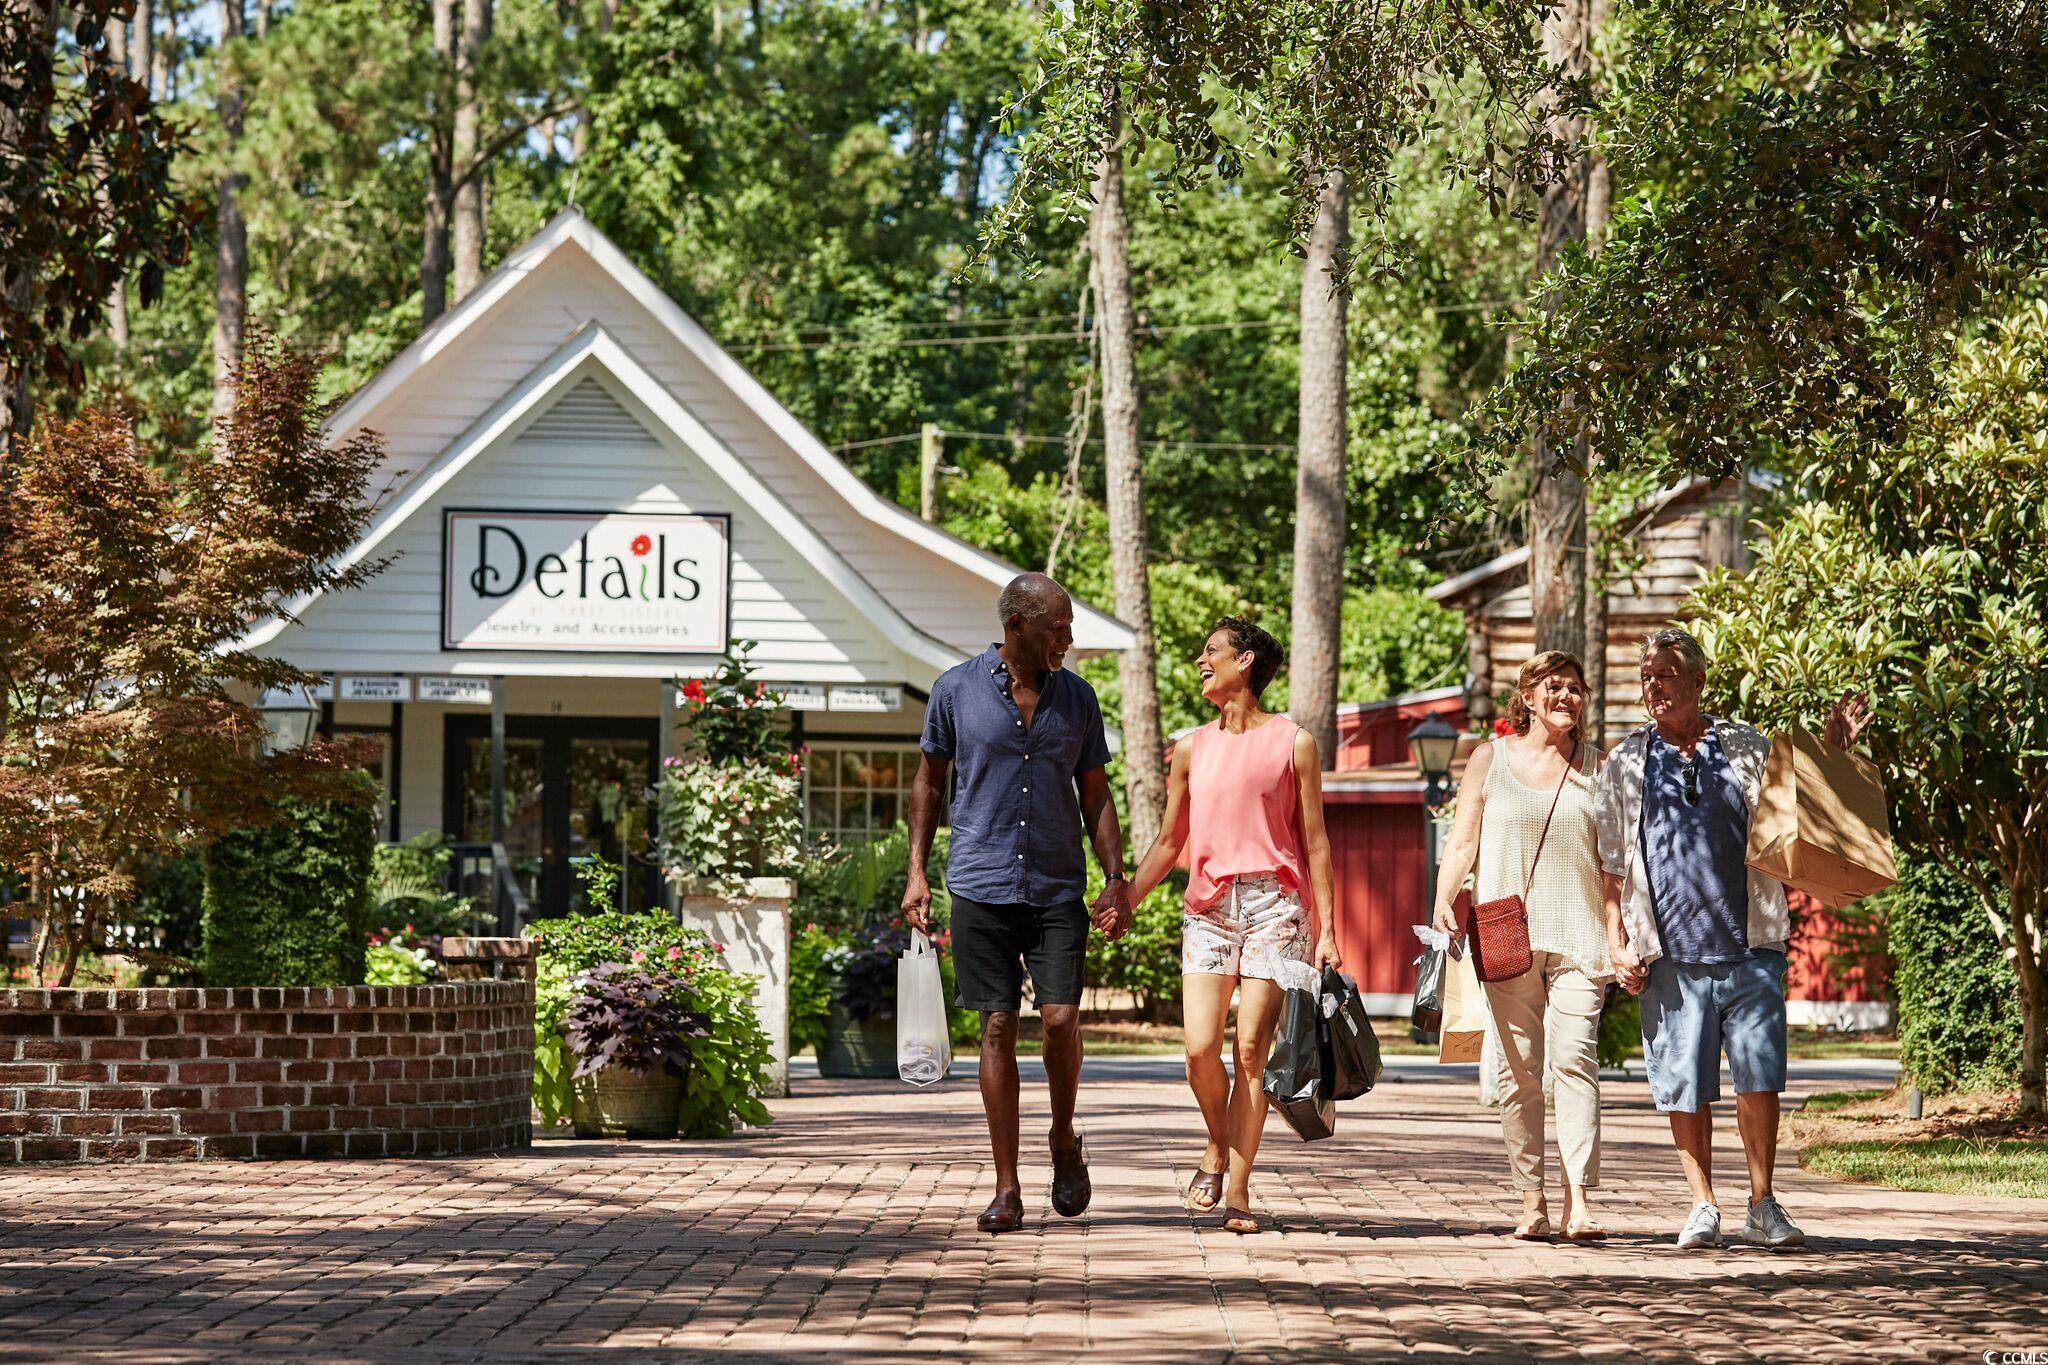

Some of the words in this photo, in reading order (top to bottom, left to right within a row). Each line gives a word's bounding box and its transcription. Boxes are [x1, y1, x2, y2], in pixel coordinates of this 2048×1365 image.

[470, 524, 701, 602] Details
[485, 619, 542, 636] Jewelry
[553, 622, 580, 635] and
[592, 622, 690, 637] Accessories
[352, 679, 399, 688] FASHION
[352, 688, 401, 697] JEWELRY
